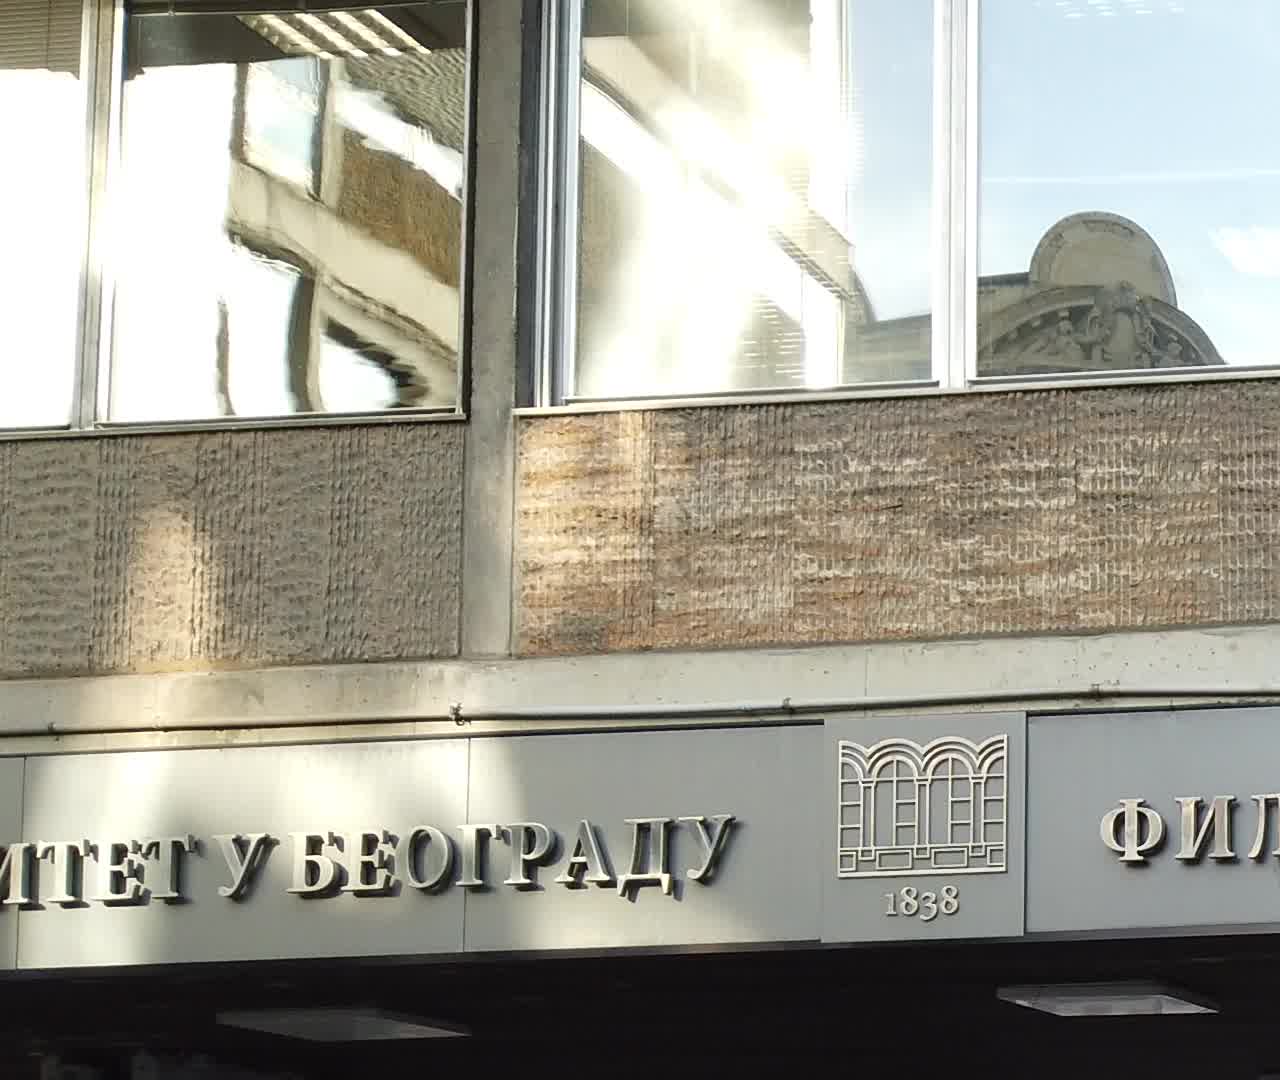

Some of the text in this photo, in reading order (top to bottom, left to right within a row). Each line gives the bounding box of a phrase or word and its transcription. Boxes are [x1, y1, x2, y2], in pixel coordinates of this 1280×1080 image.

[211, 832, 279, 899] У
[285, 812, 738, 900] БЕОГРАДУ
[884, 884, 960, 922] 1838
